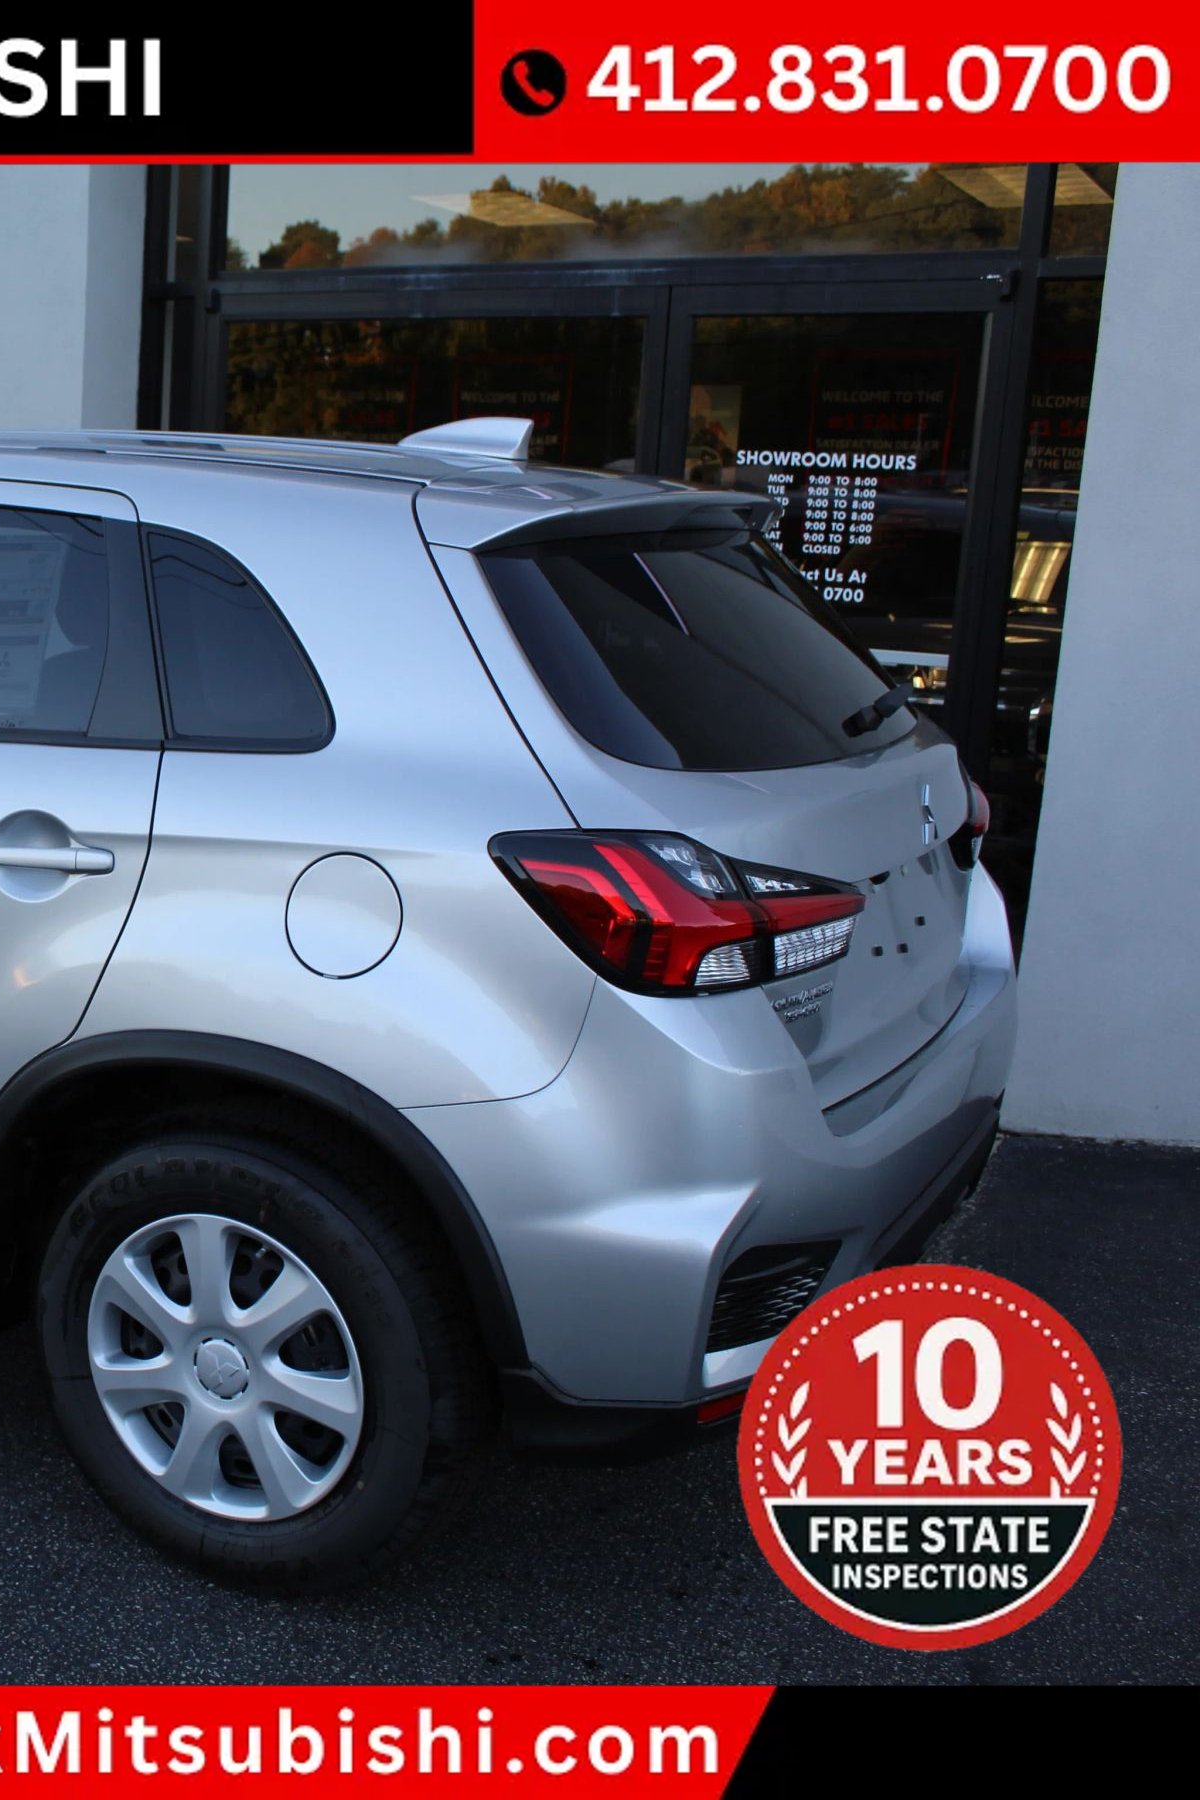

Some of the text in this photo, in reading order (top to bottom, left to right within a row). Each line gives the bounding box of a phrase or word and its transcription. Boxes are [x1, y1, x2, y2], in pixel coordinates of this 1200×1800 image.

[736, 450, 916, 470] SHOWROOM HOURS
[767, 473, 878, 487] MON 9:00 TO 8:00
[767, 484, 877, 498] TUE 9:00 TO 8:00
[806, 498, 829, 508] 9:00
[834, 499, 848, 509] TO
[852, 500, 875, 510] 8:00
[805, 510, 874, 521] 9:00 TO 8:00
[804, 521, 872, 533] 9:00 TO 6:00
[803, 533, 825, 543] 9:00
[829, 534, 843, 543] TO
[849, 535, 872, 545] 5:00
[802, 545, 841, 555] CLOSED
[824, 568, 844, 583] Us
[848, 569, 868, 584] At
